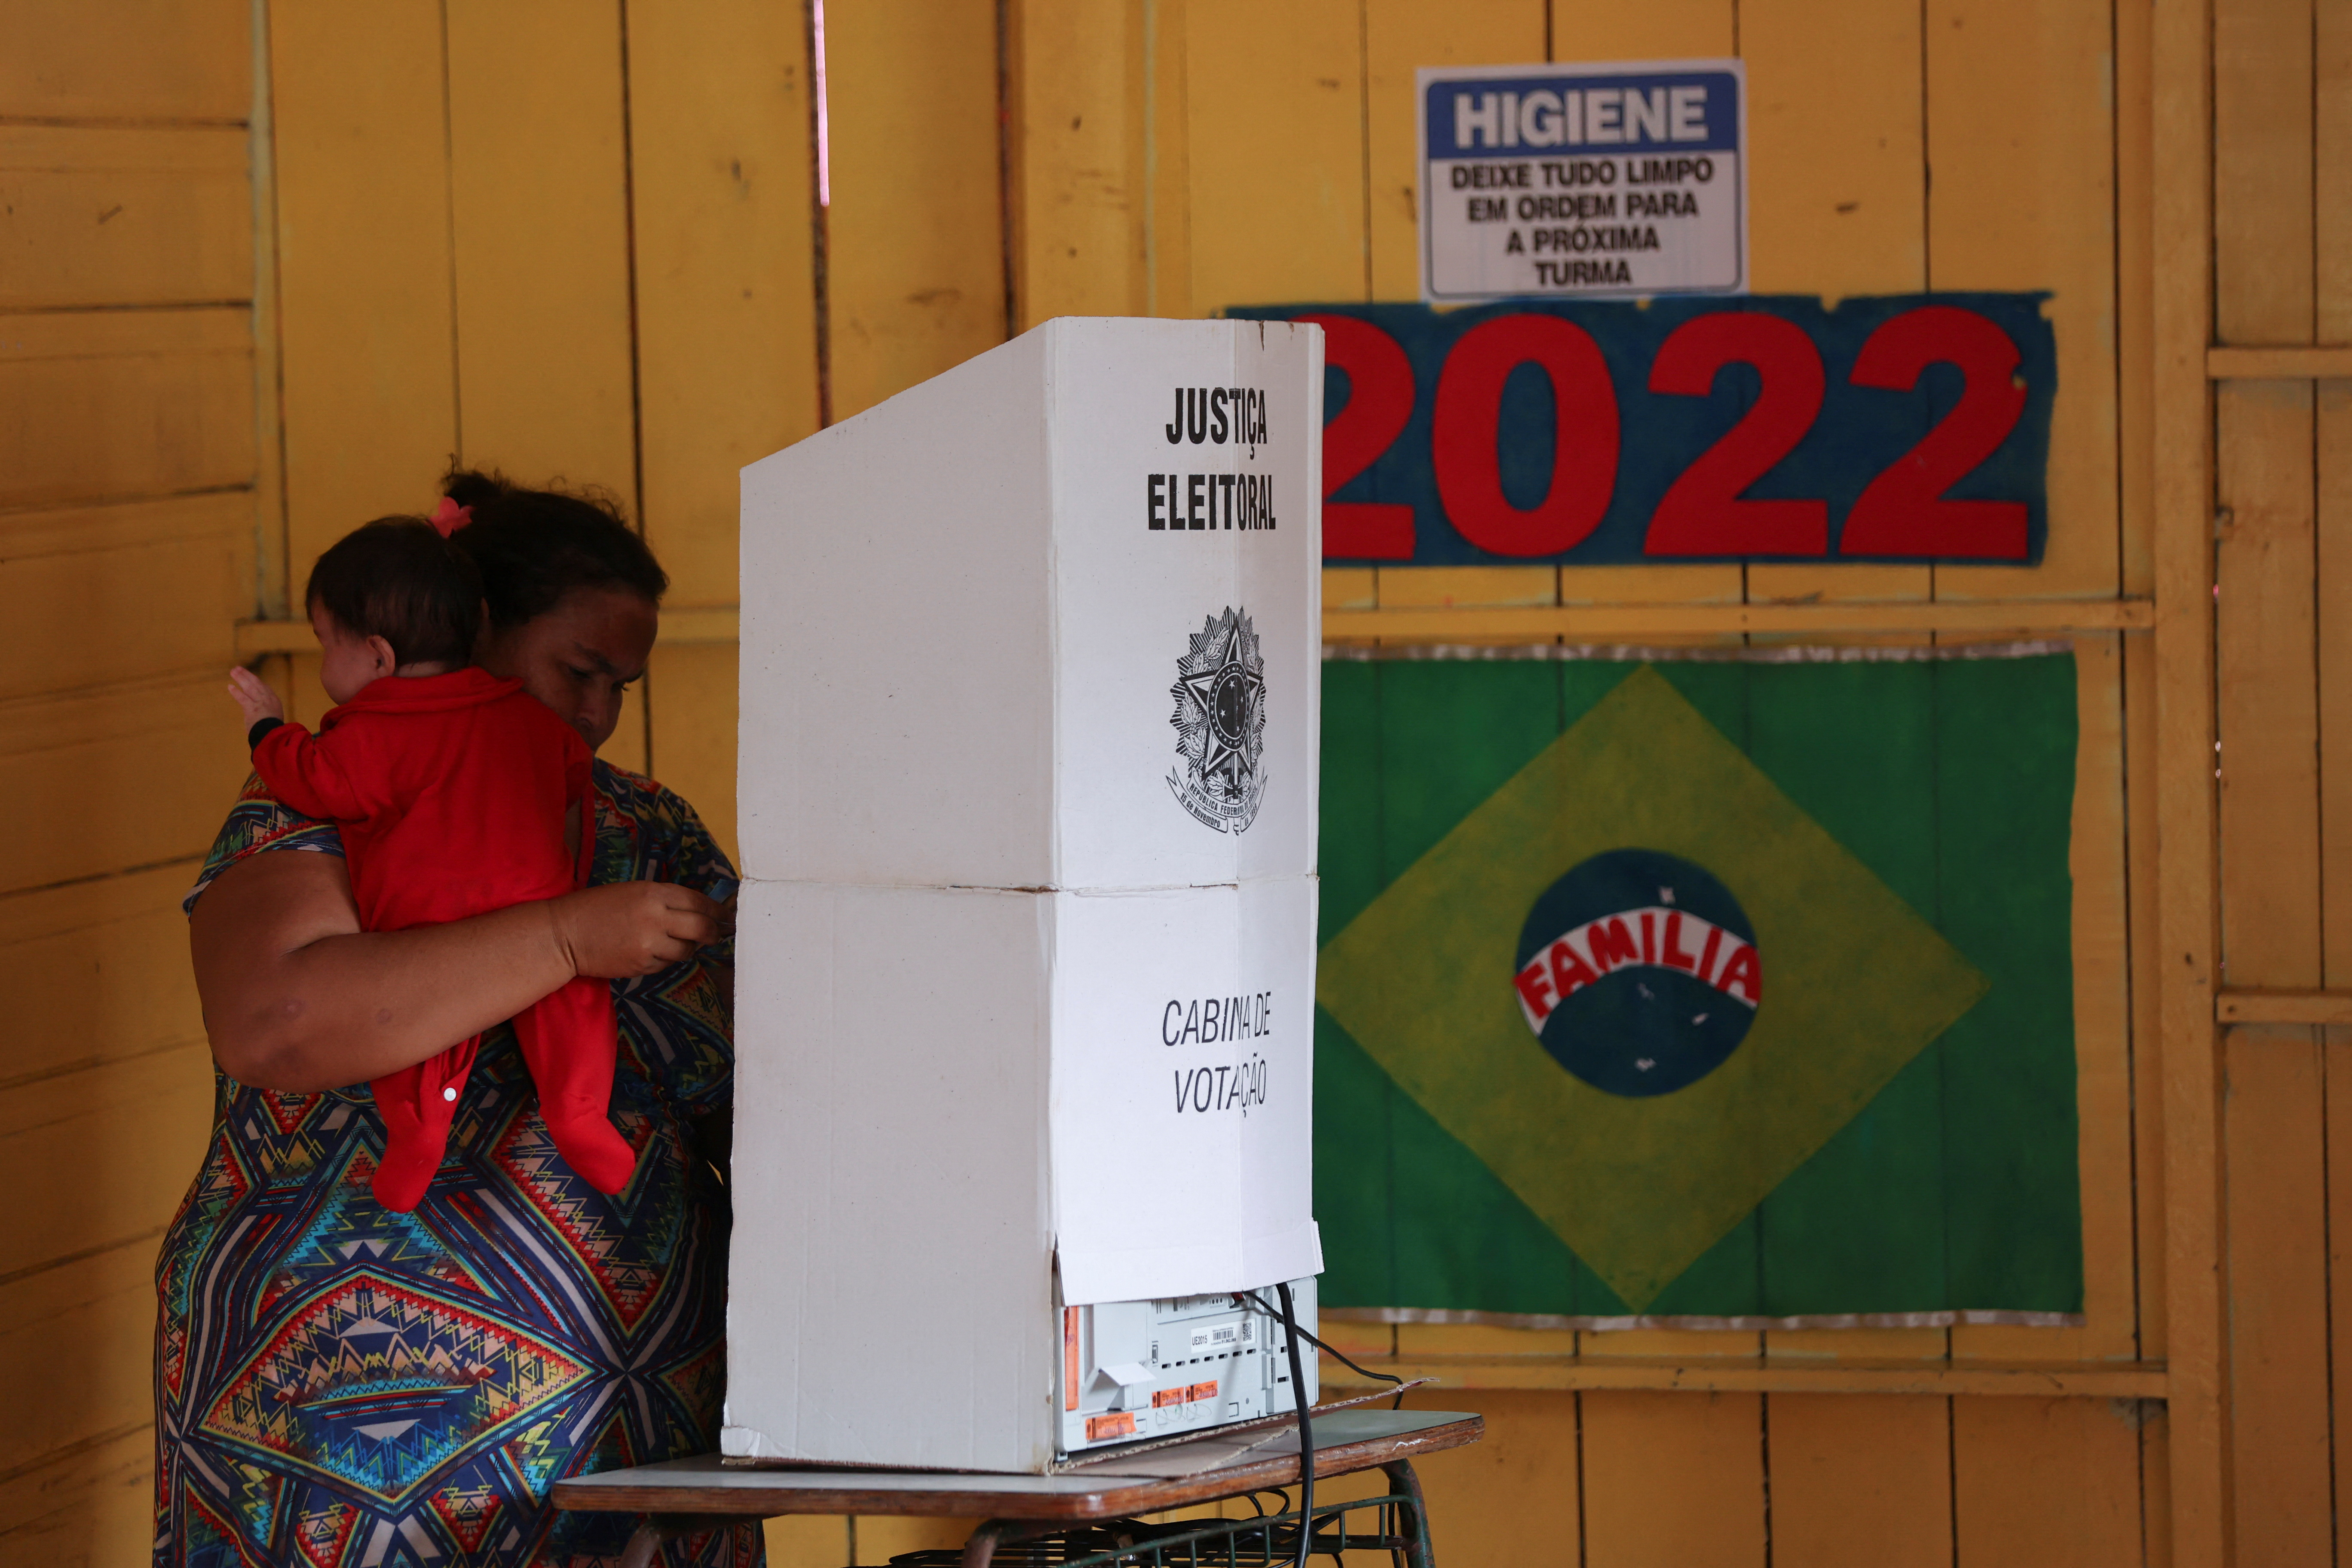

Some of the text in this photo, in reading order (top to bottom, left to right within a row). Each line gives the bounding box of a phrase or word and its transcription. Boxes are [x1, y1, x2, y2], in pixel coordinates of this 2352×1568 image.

[1453, 86, 1709, 150] HIGIENE
[1452, 157, 1714, 190] DEIXE TUDO LIMPO
[1468, 191, 1699, 222] EM ORDEM PARA
[1506, 221, 1661, 254] A PRÓXIMA
[1535, 261, 1632, 286] TURMA
[1166, 387, 1268, 460] JUSTIÇA
[1293, 306, 2028, 559] 2022
[1148, 473, 1276, 530] ELEITORAL
[1180, 792, 1187, 803] 15
[1186, 800, 1194, 810] de
[1194, 805, 1221, 828] Novembro
[1189, 783, 1218, 812] REPÚBLICA
[1513, 909, 1762, 1020] FAMILIA
[1162, 991, 1271, 1046] CABINA DE
[1175, 1051, 1266, 1118] VOTAÇÃO
[1192, 1335, 1208, 1346] UE2015
